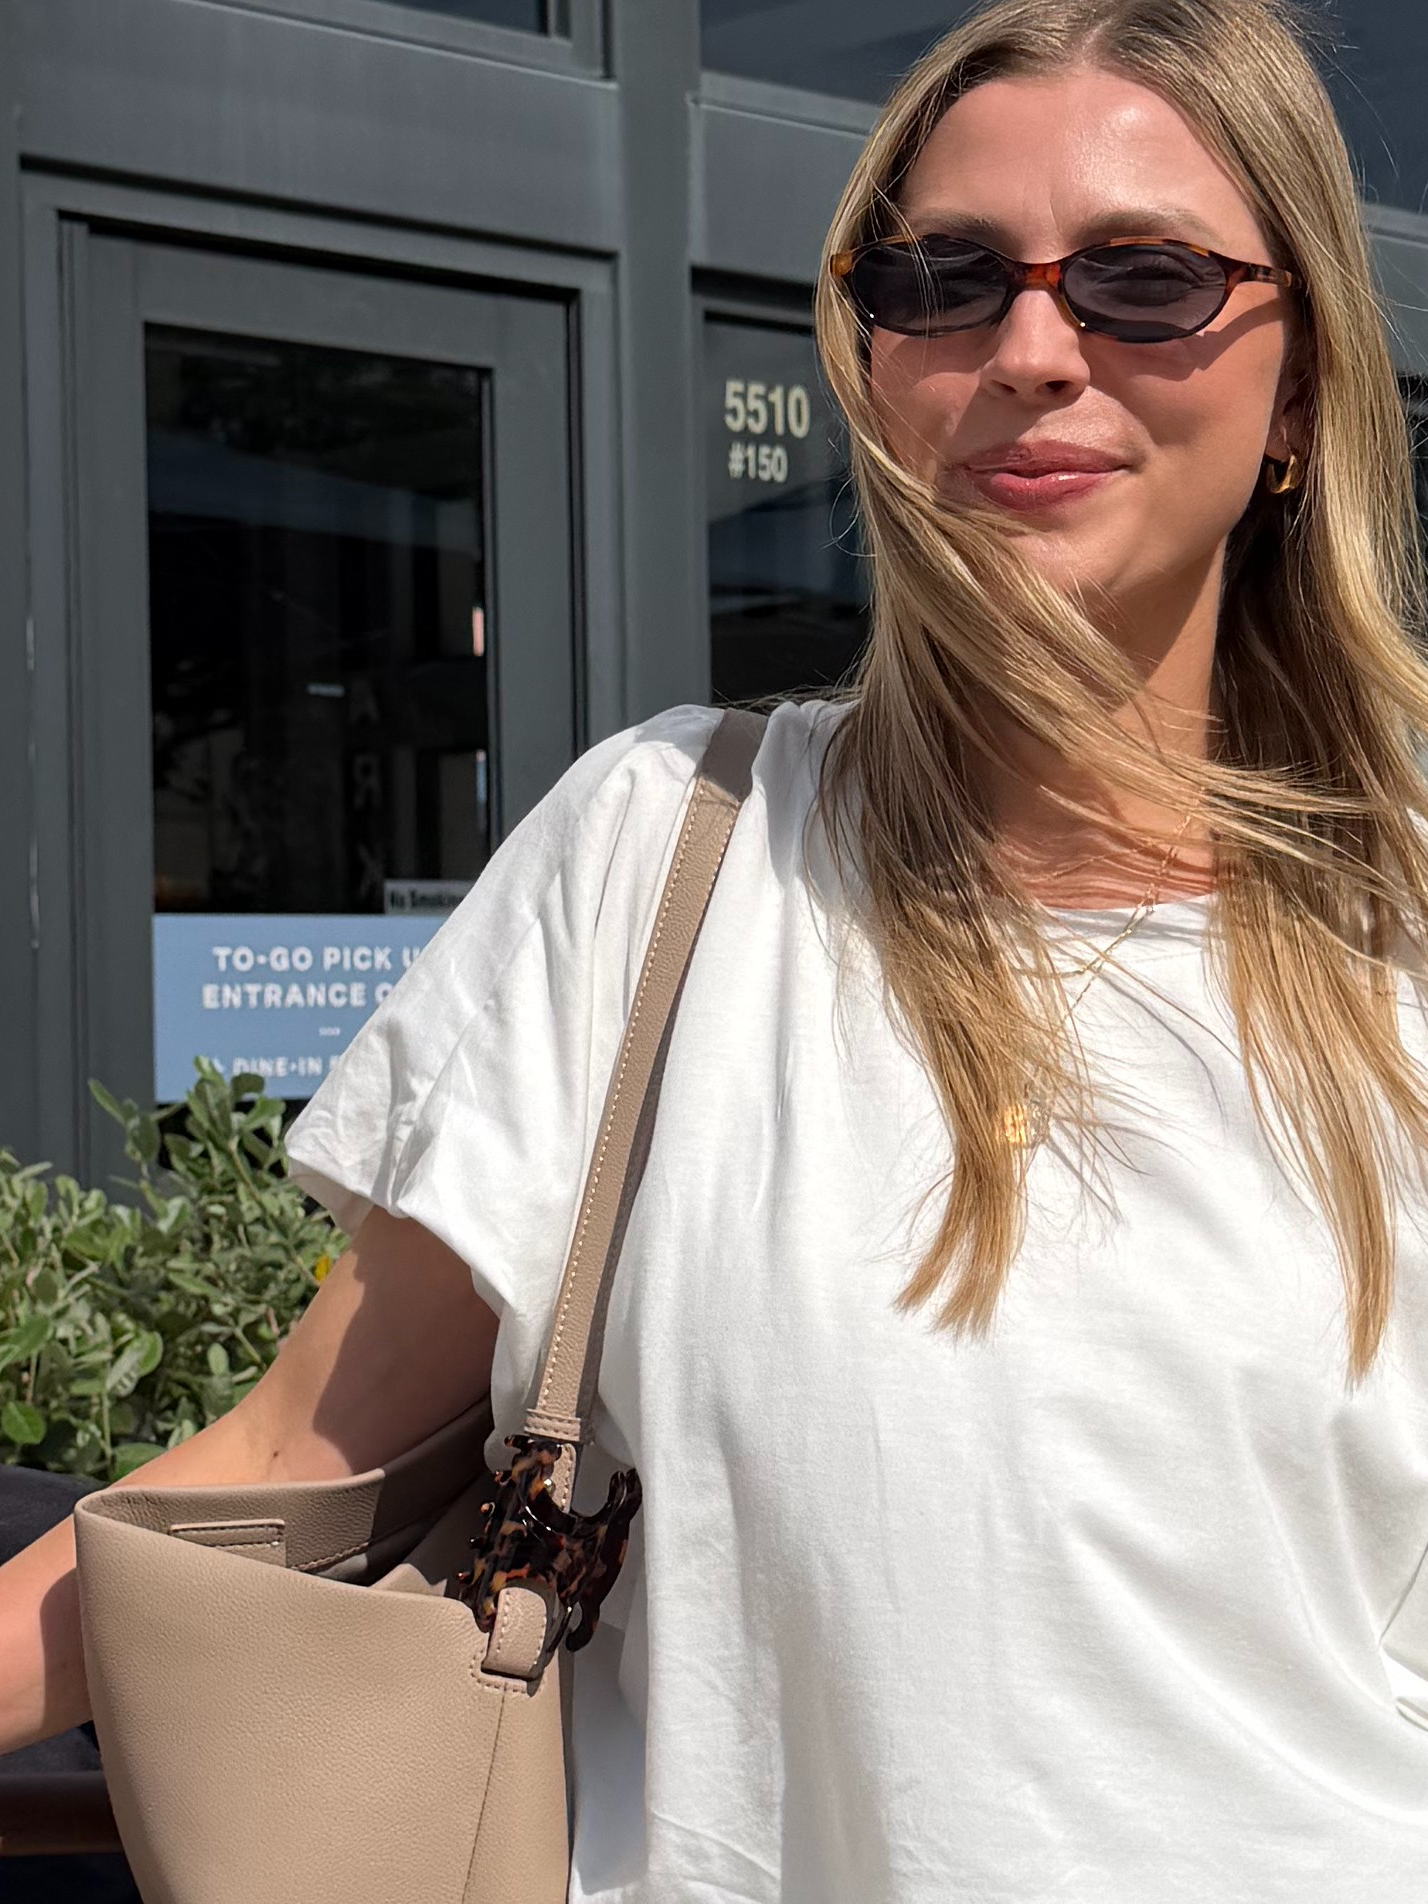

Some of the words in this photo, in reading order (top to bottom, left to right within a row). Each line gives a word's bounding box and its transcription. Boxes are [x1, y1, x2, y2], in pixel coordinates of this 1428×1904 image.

[725, 380, 810, 438] 5510
[728, 442, 788, 483] #150
[323, 946, 392, 972] PICK
[402, 946, 421, 968] U
[202, 982, 366, 1009] ENTRANCE
